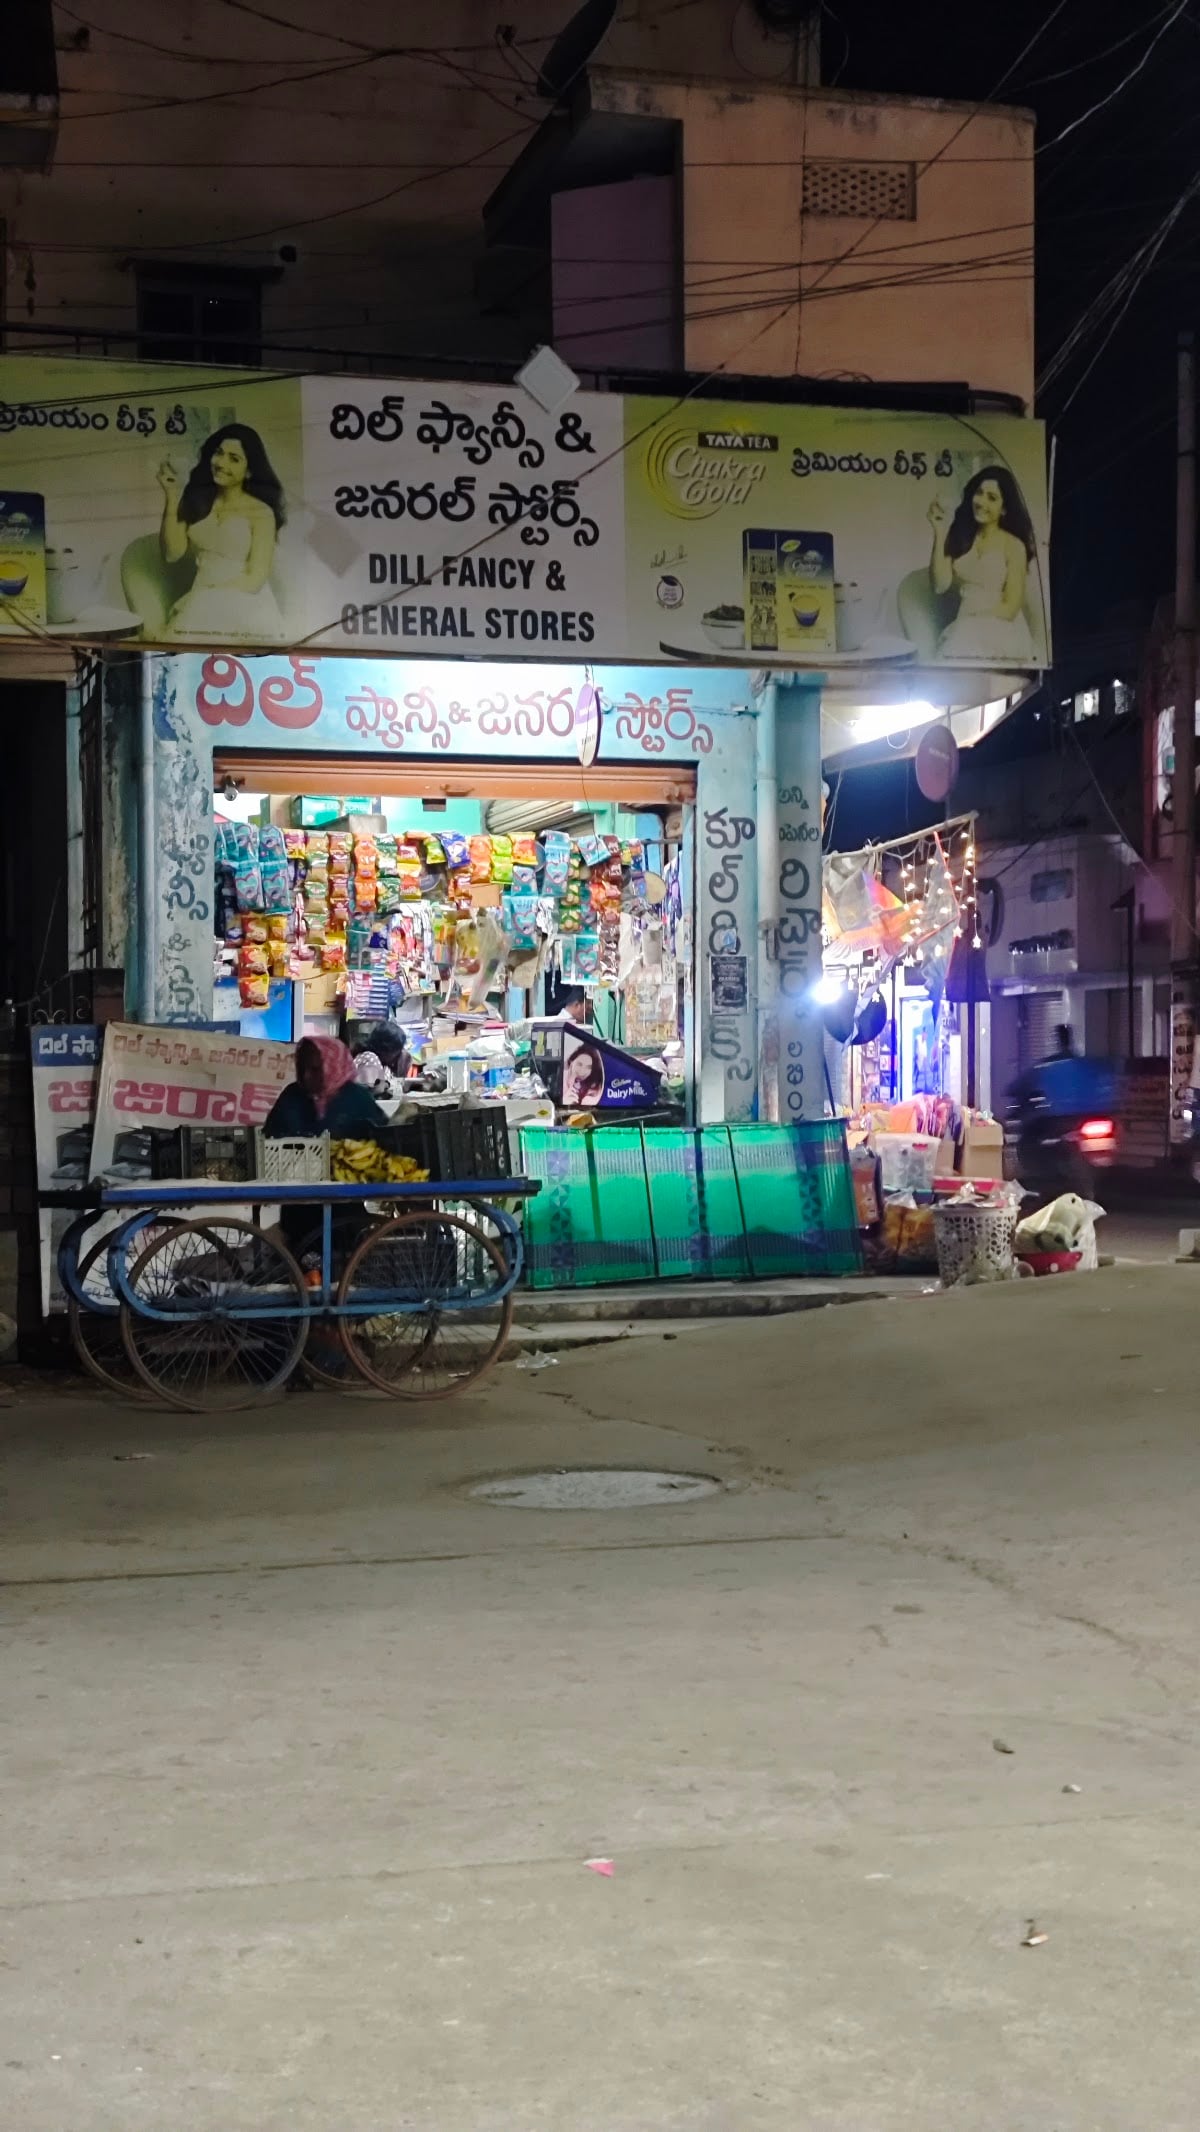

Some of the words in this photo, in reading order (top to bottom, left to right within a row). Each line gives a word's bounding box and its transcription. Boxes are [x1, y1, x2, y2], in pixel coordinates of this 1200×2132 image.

[329, 396, 404, 442] దిల్
[554, 412, 597, 453] &
[705, 434, 744, 448] TATA
[747, 436, 771, 449] TEA
[669, 445, 767, 482] Chakra
[681, 479, 753, 506] Gold
[334, 476, 477, 522] జనరల్
[488, 480, 600, 547] స్టోర్స్
[368, 553, 433, 586] DILL
[442, 556, 536, 590] FANCY
[545, 559, 567, 591] &
[340, 603, 475, 637] GENERAL
[484, 607, 596, 643] STORES
[607, 1087, 629, 1100] Dairy
